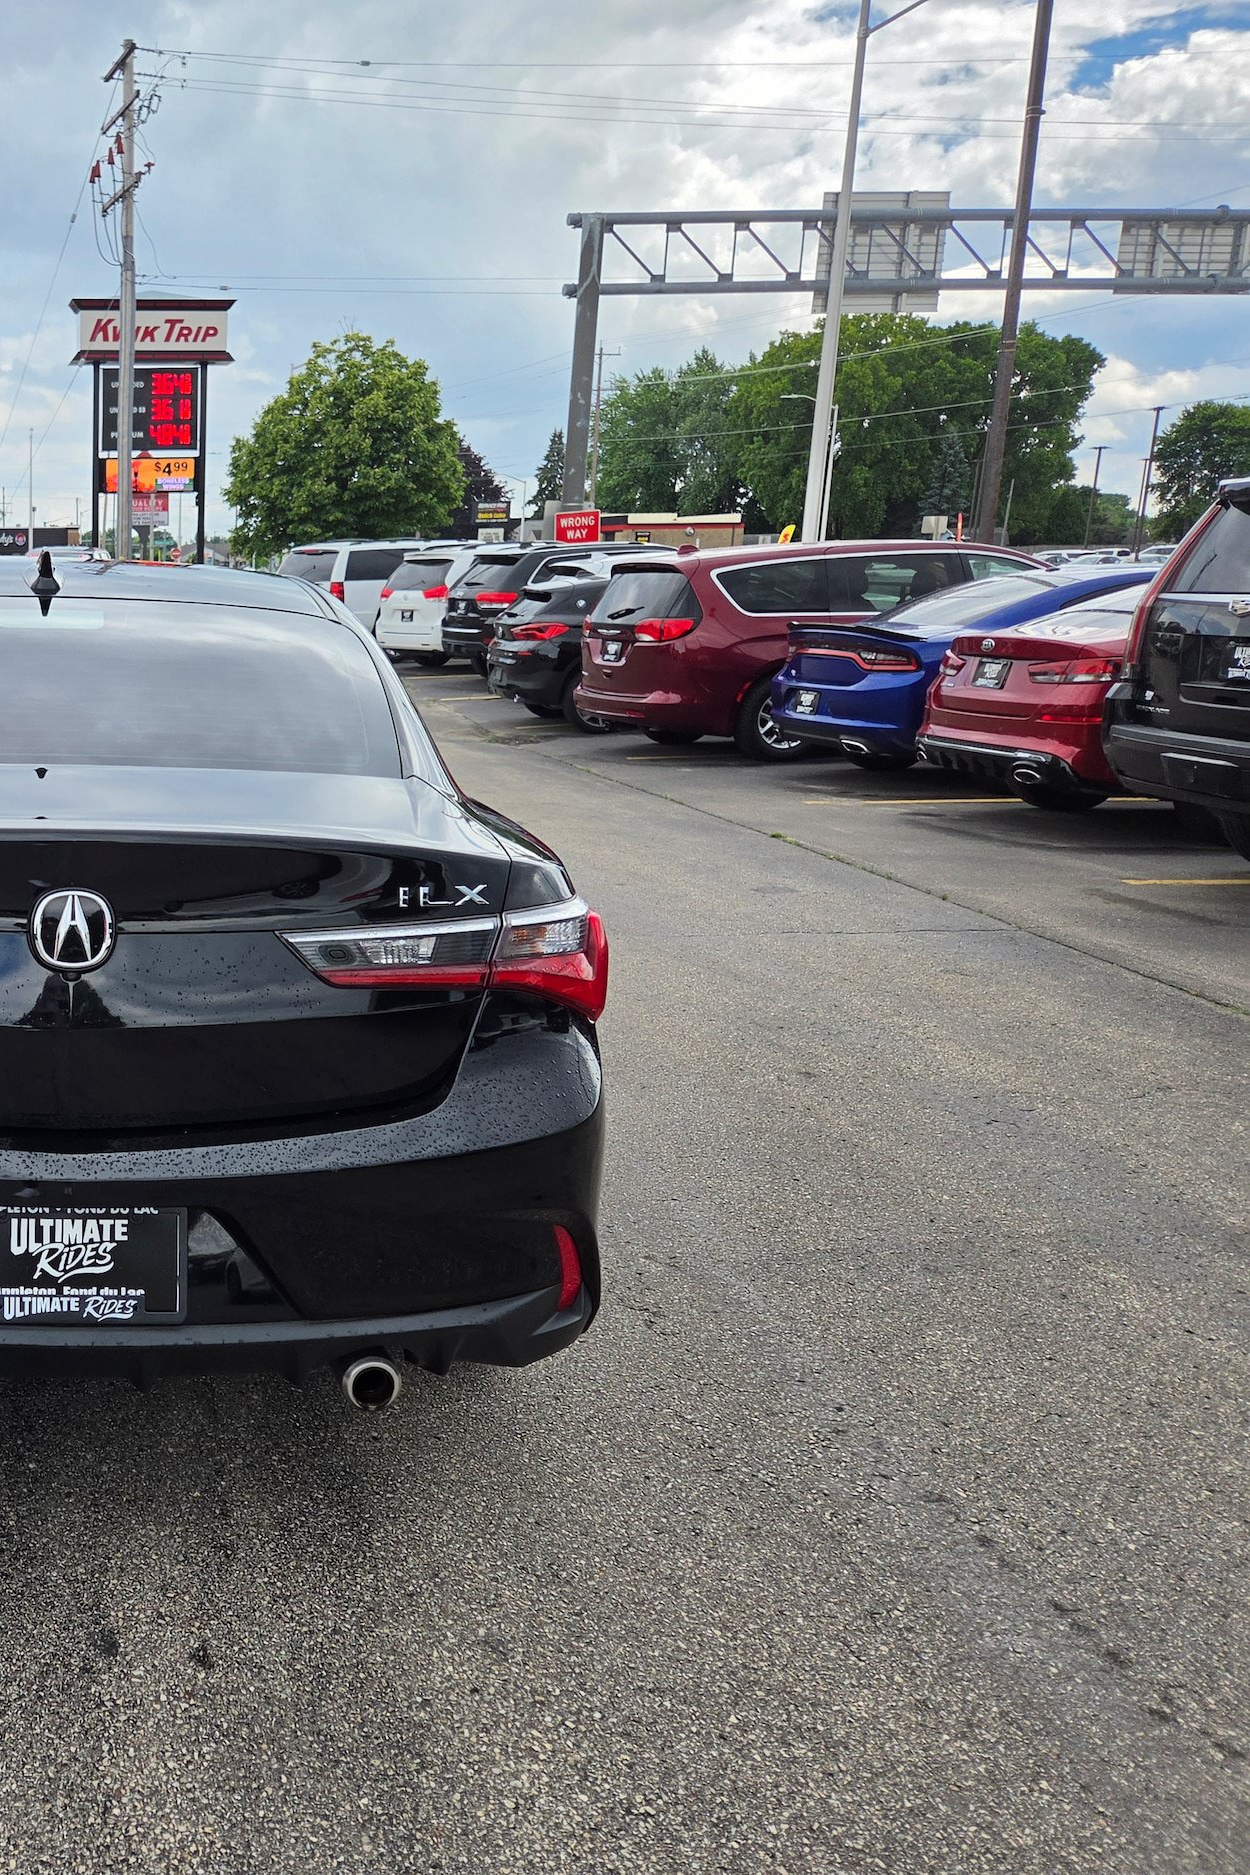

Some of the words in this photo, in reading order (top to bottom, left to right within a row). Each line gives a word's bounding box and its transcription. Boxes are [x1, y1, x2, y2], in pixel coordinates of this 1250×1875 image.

[89, 318, 161, 343] KIK
[164, 318, 219, 343] TRIP
[559, 515, 596, 529] WRONG
[566, 528, 589, 540] WAY
[10, 1217, 129, 1256] ULTIMATE
[3, 1296, 80, 1321] ULTIMATE
